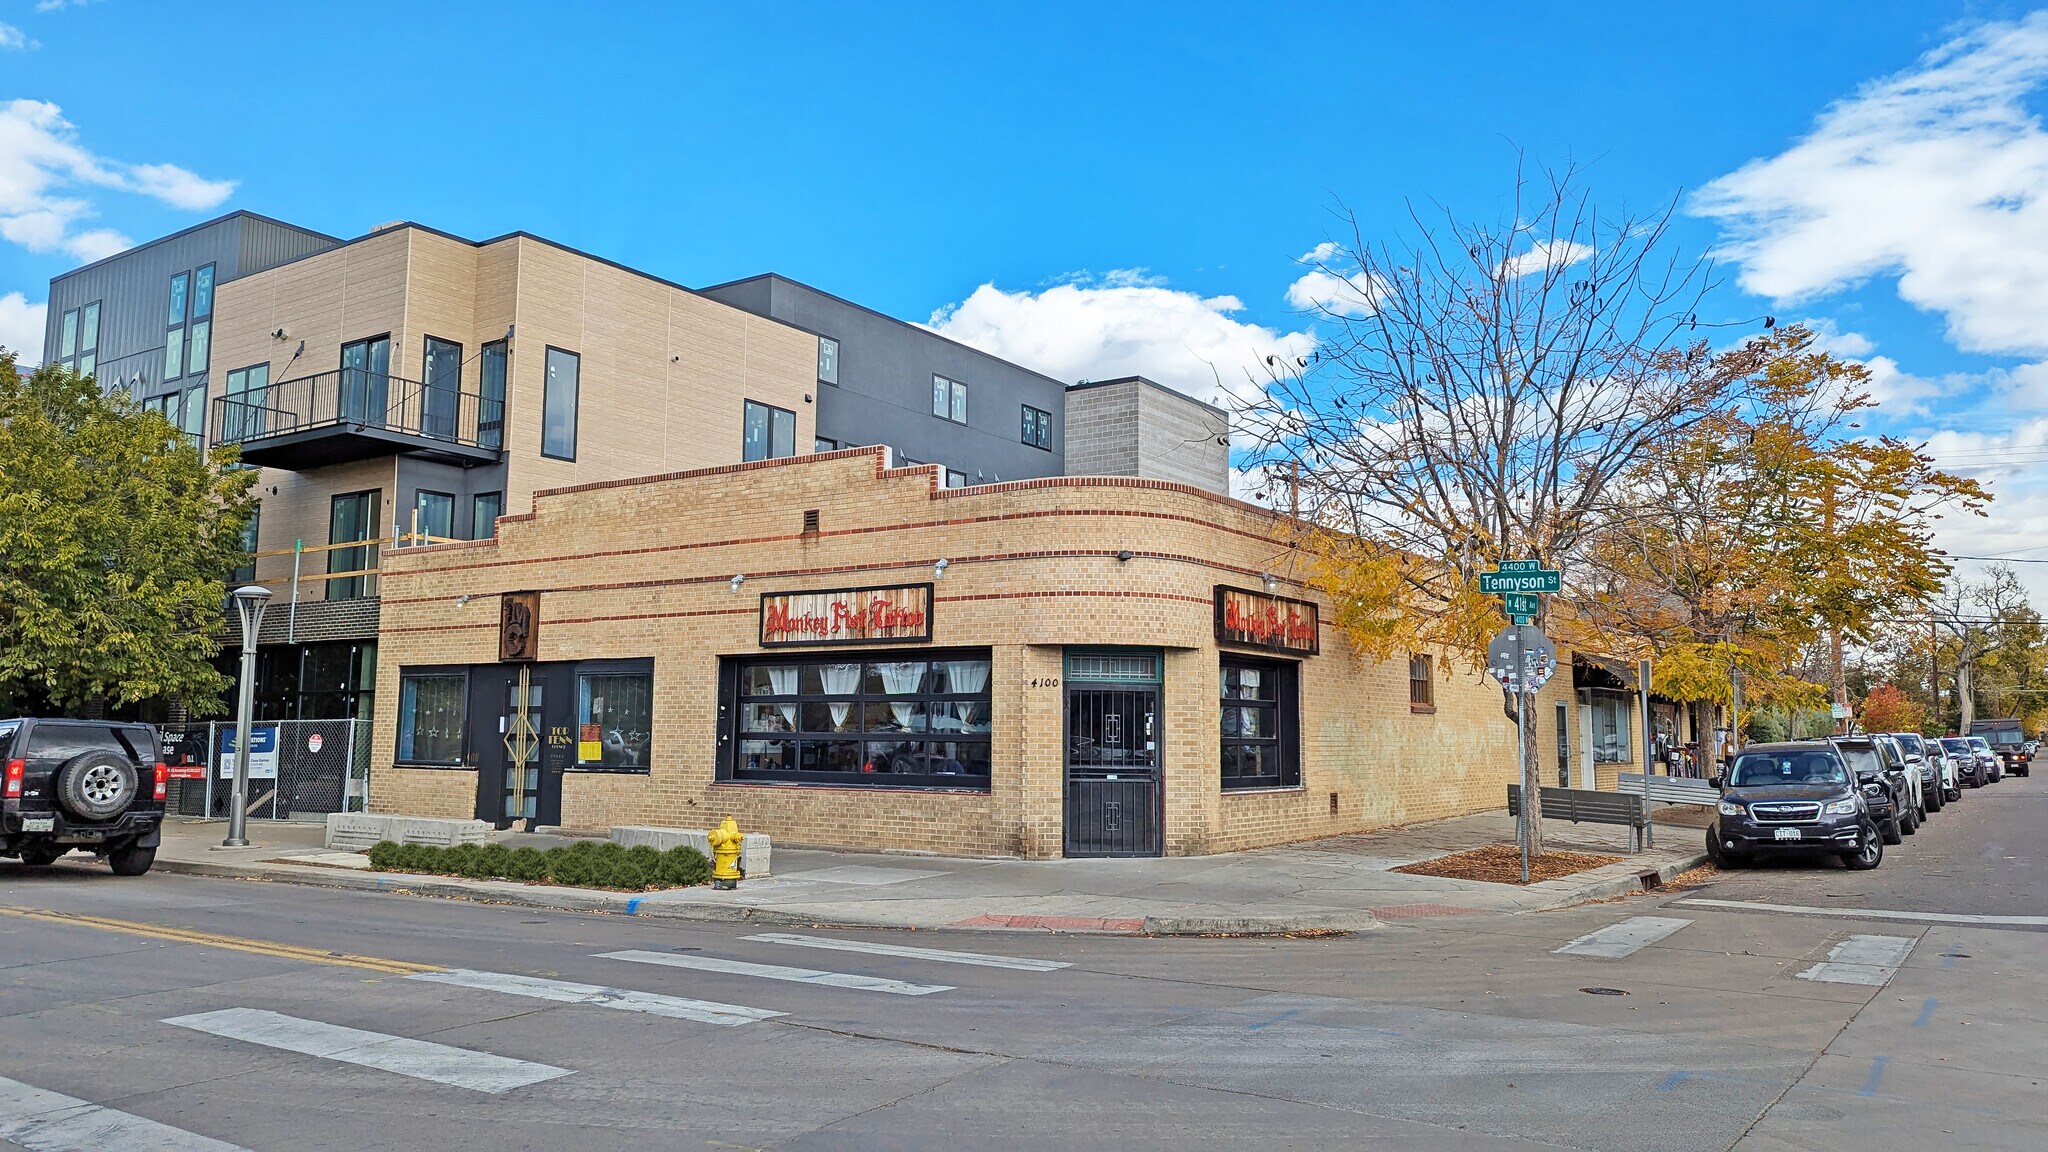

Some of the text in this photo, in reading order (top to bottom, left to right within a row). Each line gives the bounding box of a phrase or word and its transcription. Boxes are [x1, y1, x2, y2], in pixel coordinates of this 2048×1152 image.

[1529, 562, 1536, 570] W
[1483, 576, 1557, 591] Tennyson St
[1514, 597, 1527, 612] 41st
[766, 596, 924, 636] Monkey Fist Tattoo
[1031, 678, 1059, 687] 4100
[551, 726, 569, 735] TOP
[164, 731, 185, 744] Space
[548, 735, 573, 744] TENN
